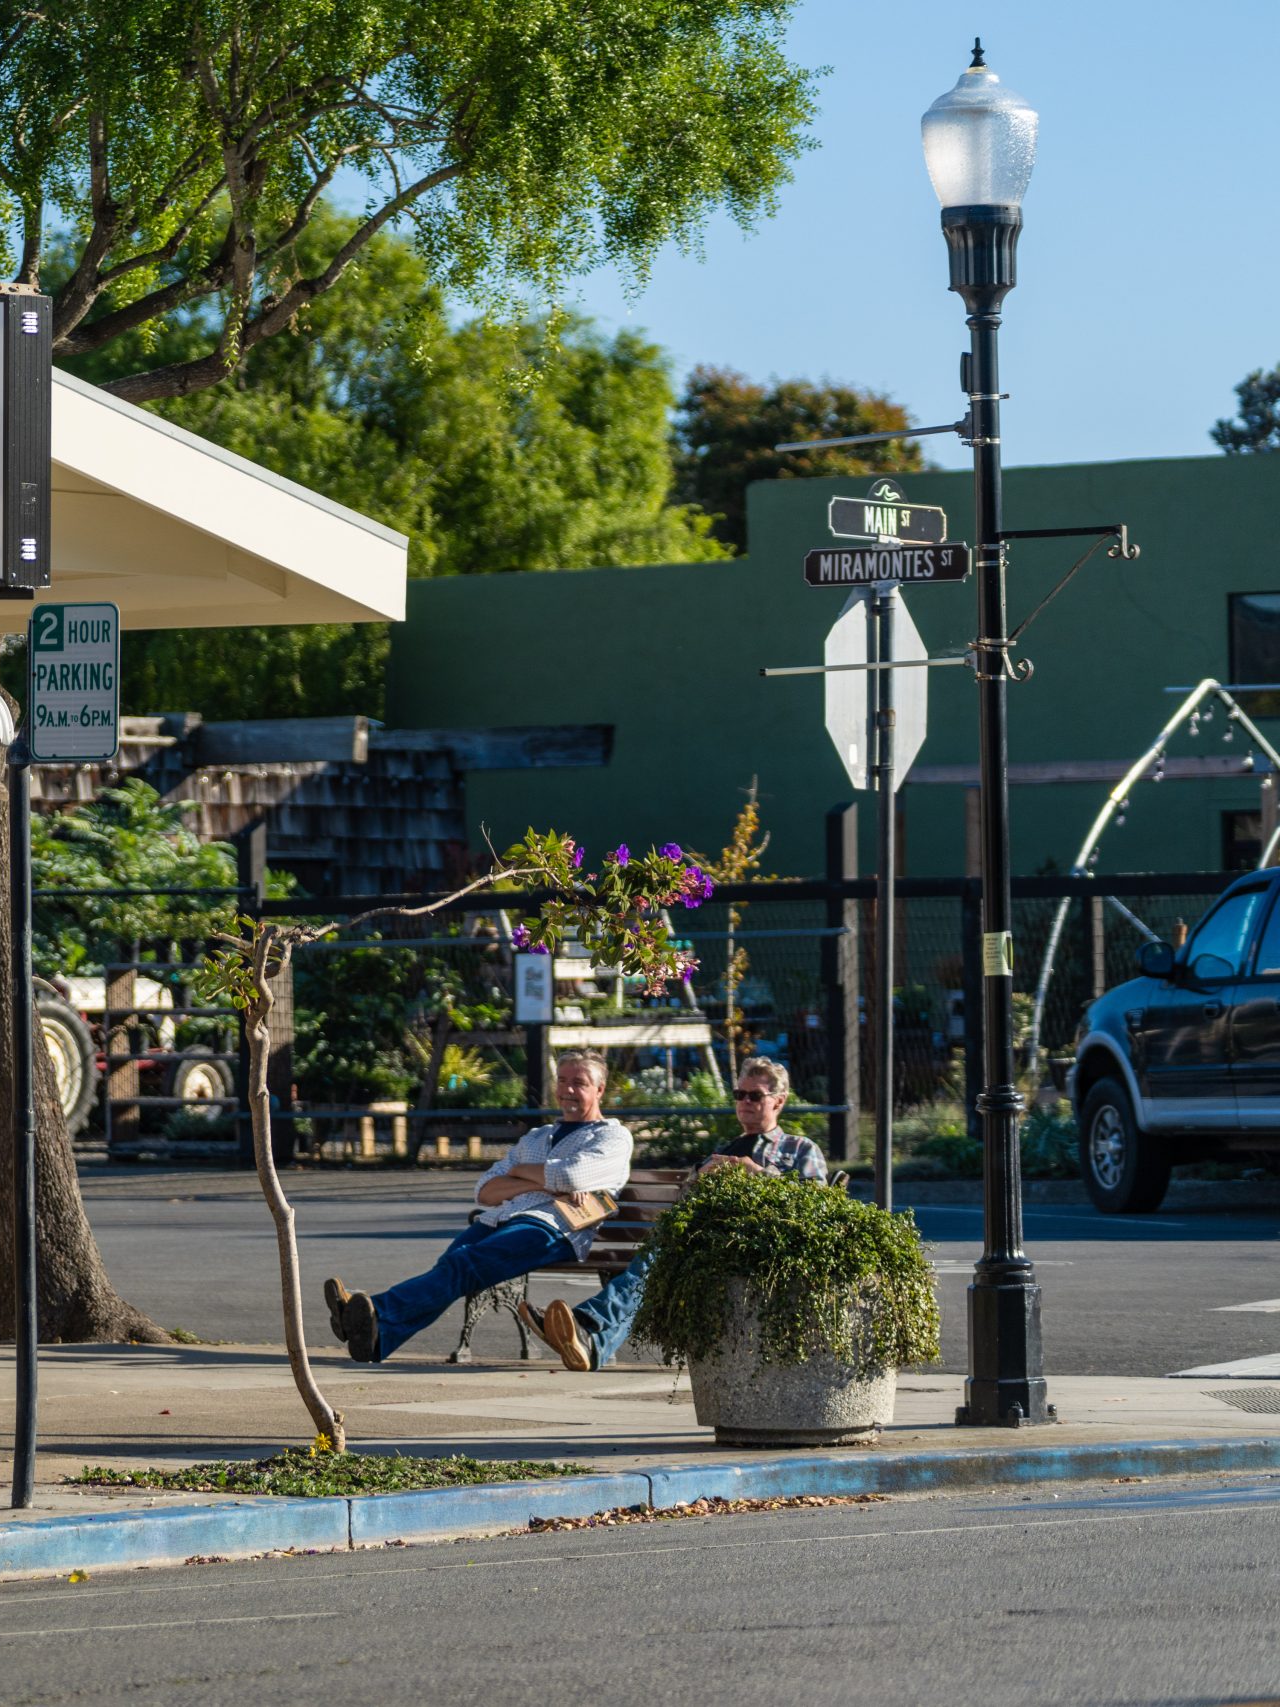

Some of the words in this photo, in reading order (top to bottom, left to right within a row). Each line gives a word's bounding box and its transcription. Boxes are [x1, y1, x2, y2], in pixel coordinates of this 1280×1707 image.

[863, 505, 897, 536] MAIN
[900, 509, 911, 527] ST
[819, 549, 935, 581] MIRAMONTES
[940, 549, 953, 567] ST
[39, 612, 58, 645] 2
[68, 620, 111, 644] HOUR
[36, 662, 113, 692] PARKING
